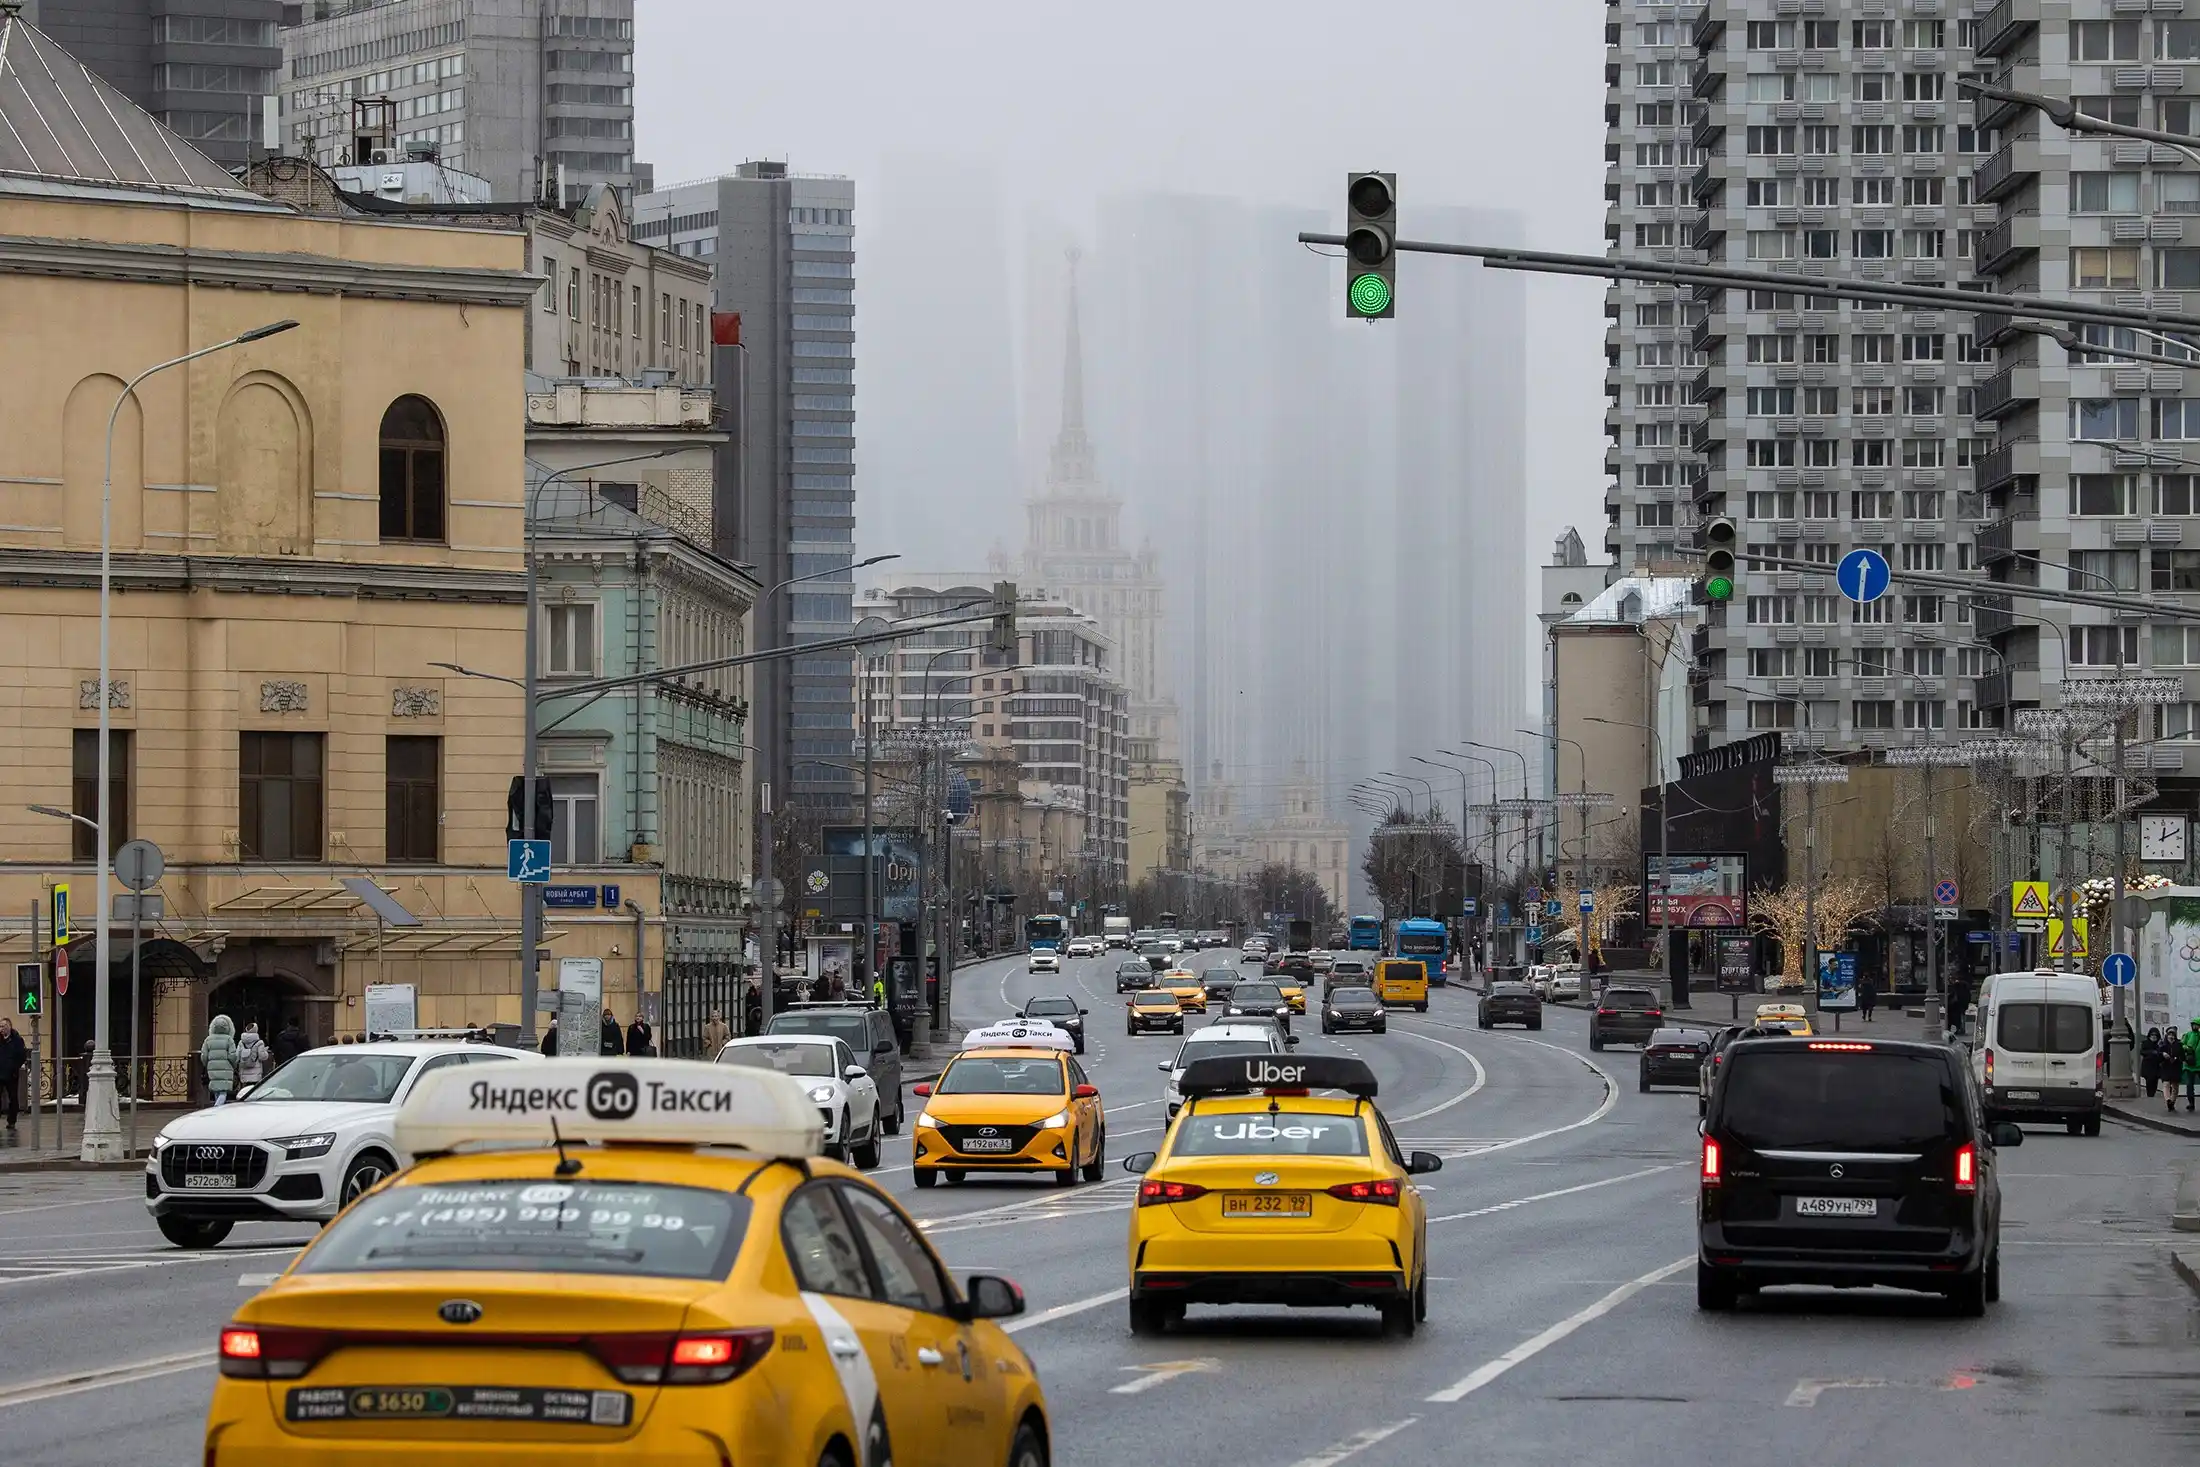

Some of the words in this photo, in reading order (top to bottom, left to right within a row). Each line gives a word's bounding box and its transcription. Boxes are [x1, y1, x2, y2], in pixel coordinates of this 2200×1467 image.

[546, 888, 567, 898] НОВЫЙ
[569, 890, 588, 898] АРБАТ
[610, 889, 615, 899] 1
[1246, 1061, 1306, 1083] Uber
[469, 1080, 578, 1114] Яндекс
[593, 1080, 630, 1111] Go
[645, 1081, 732, 1112] Такси
[1214, 1123, 1329, 1140] Uber
[1229, 1201, 1247, 1211] ВН
[1254, 1197, 1281, 1211] 232
[1291, 1197, 1306, 1210] 99
[518, 1207, 581, 1223] 999
[590, 1210, 631, 1225] 99
[641, 1213, 685, 1231] 99
[444, 1306, 474, 1320] KIA
